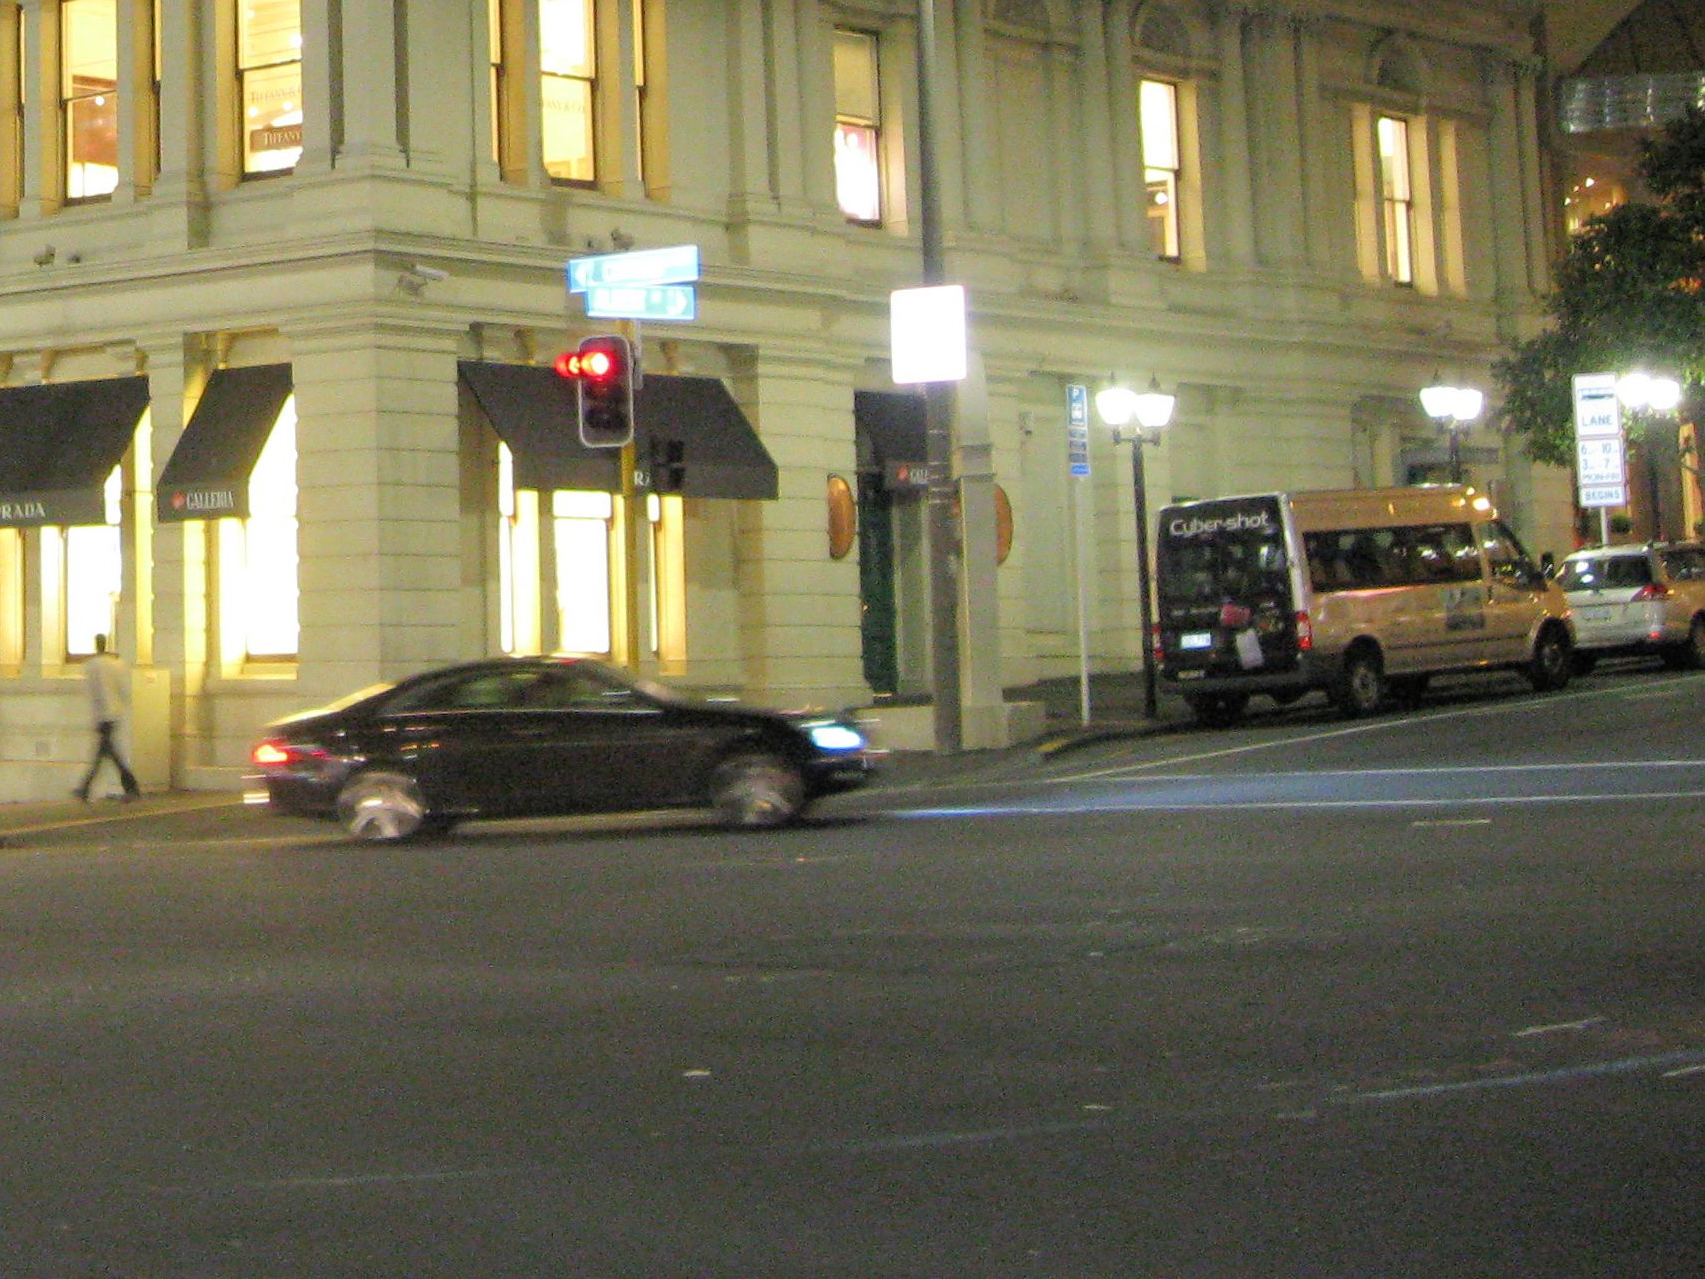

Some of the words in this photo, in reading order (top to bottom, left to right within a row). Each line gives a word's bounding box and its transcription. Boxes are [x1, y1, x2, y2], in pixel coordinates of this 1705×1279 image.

[1582, 414, 1613, 427] LANE
[186, 490, 234, 510] GALLERIA
[1169, 511, 1270, 538] Cyber-shot
